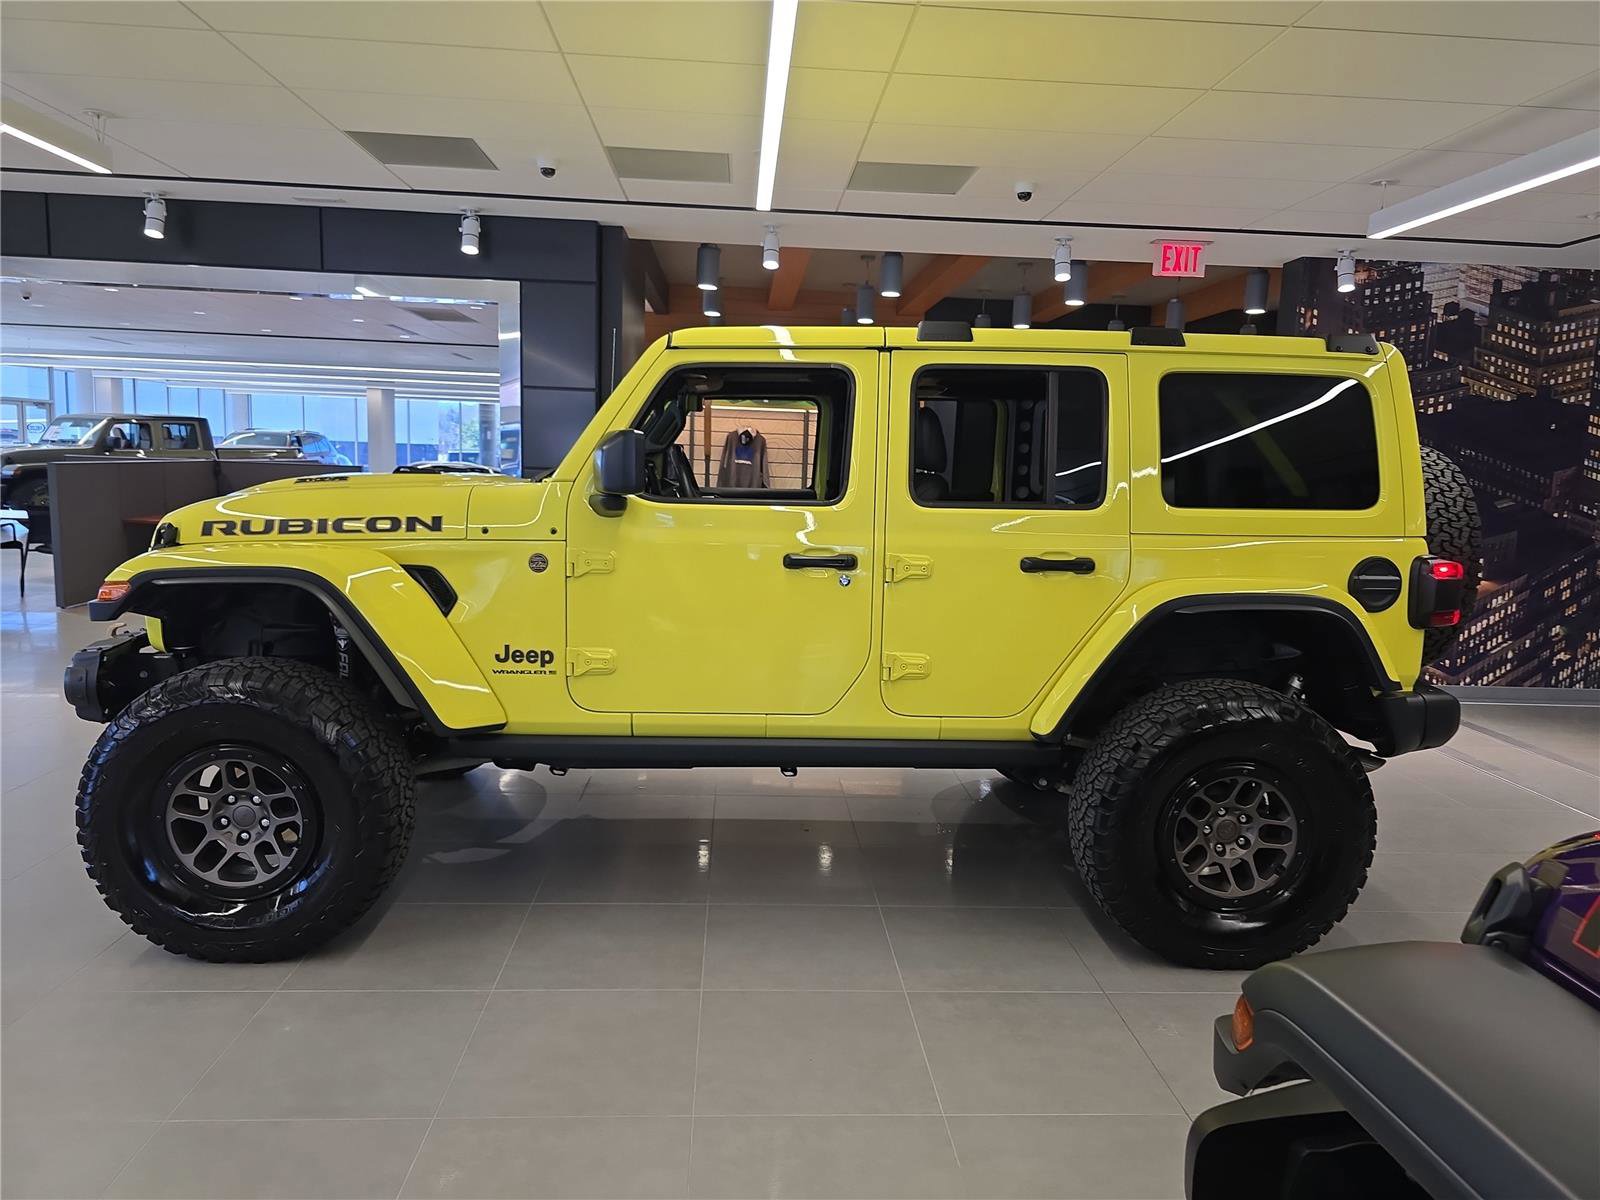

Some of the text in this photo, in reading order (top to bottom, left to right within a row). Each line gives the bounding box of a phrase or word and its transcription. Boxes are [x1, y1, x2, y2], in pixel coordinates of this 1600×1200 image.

[1161, 245, 1202, 272] EXIT
[201, 516, 443, 536] RUBICON
[494, 644, 554, 667] Jeep
